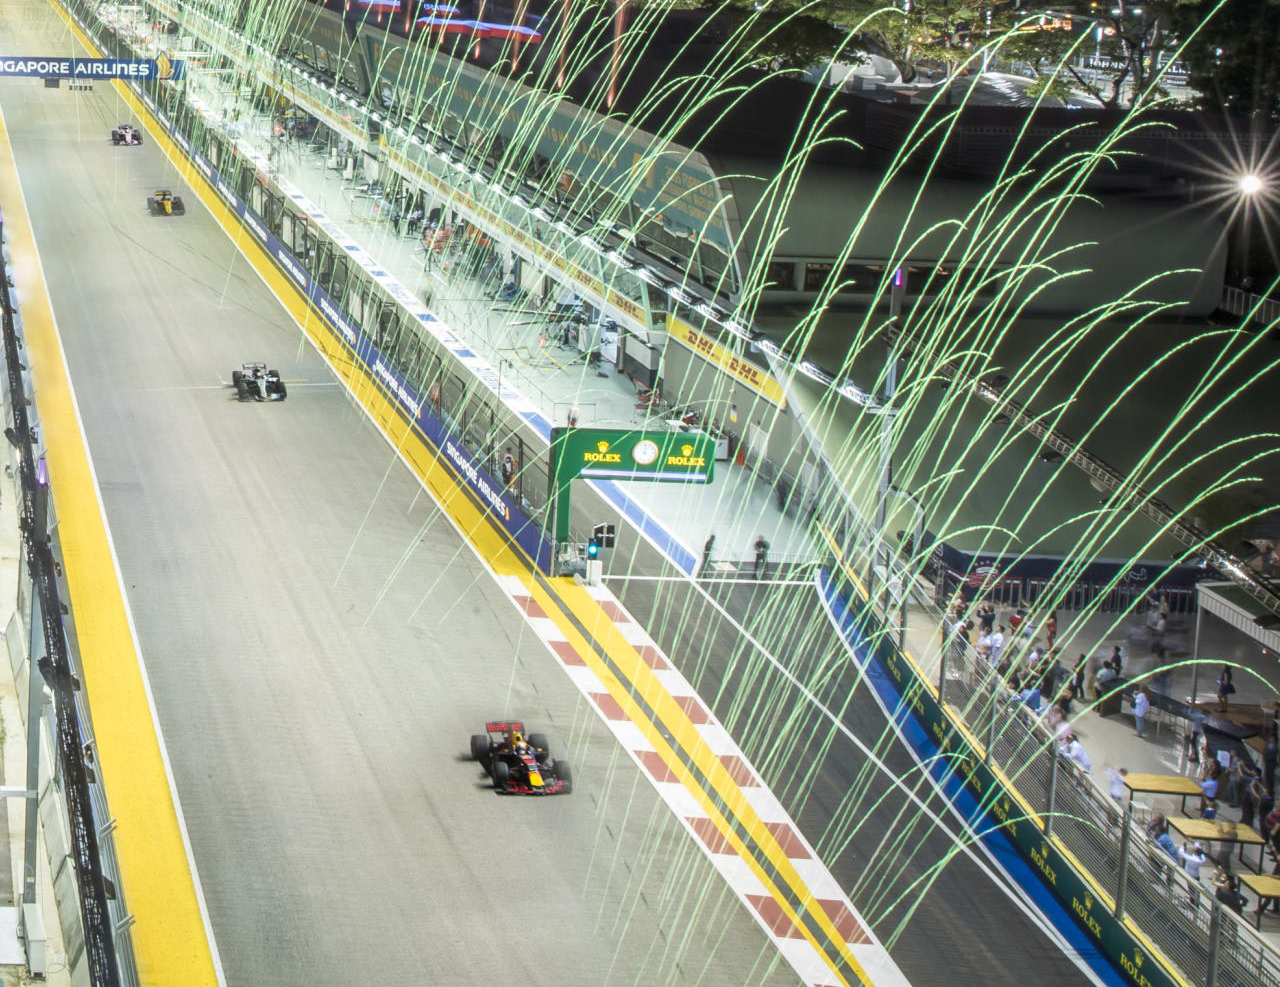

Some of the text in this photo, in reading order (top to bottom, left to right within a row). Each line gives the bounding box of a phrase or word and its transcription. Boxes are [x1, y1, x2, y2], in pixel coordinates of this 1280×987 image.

[74, 62, 150, 76] AIRLINES
[687, 329, 715, 357] DHL
[729, 356, 760, 386] DHL
[584, 452, 621, 463] ROLEX
[668, 456, 705, 467] ROLEX
[446, 441, 506, 517] SINGAPORE AIRLINES
[1030, 846, 1057, 886] ROLEX
[1072, 896, 1102, 940] ROLEX
[1120, 952, 1153, 987] ROLE
